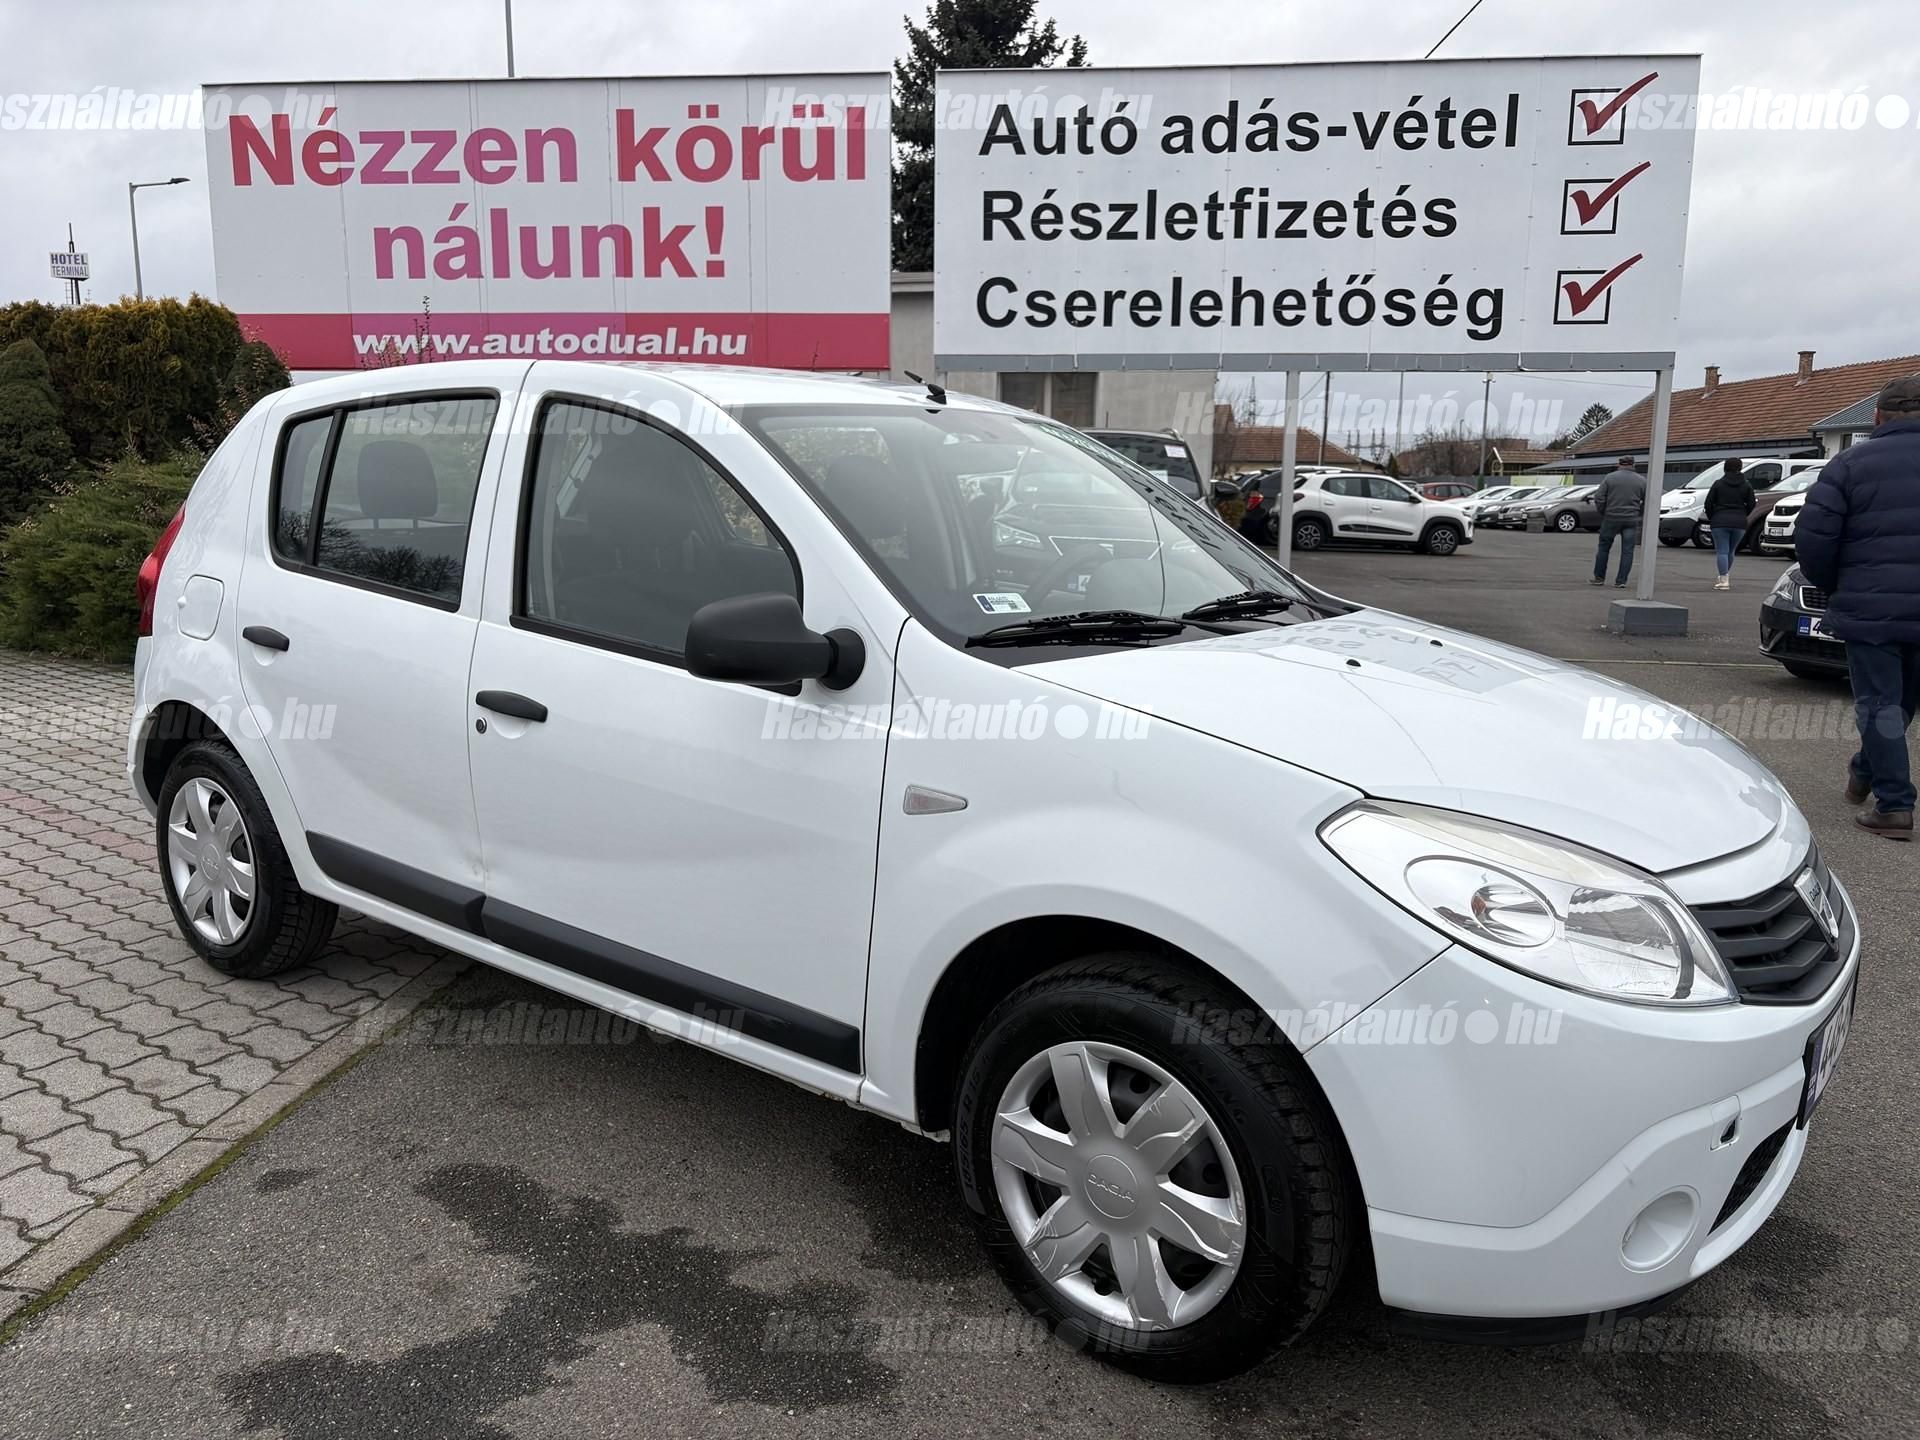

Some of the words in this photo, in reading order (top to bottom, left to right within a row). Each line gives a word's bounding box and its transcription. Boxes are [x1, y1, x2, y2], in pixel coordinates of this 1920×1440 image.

[229, 107, 576, 187] Nézzen
[617, 104, 866, 184] körül
[978, 102, 1138, 155] Autó
[1160, 94, 1520, 154] adás-vétel
[983, 185, 1457, 241] Részletfizetés
[50, 253, 88, 265] HOTEL
[374, 203, 726, 281] nálunk!
[51, 265, 89, 277] TERMINAL
[976, 274, 1504, 341] Cserelehetőség
[353, 327, 748, 356] www.autodual.hu
[1087, 1173, 1136, 1203] DACIA
